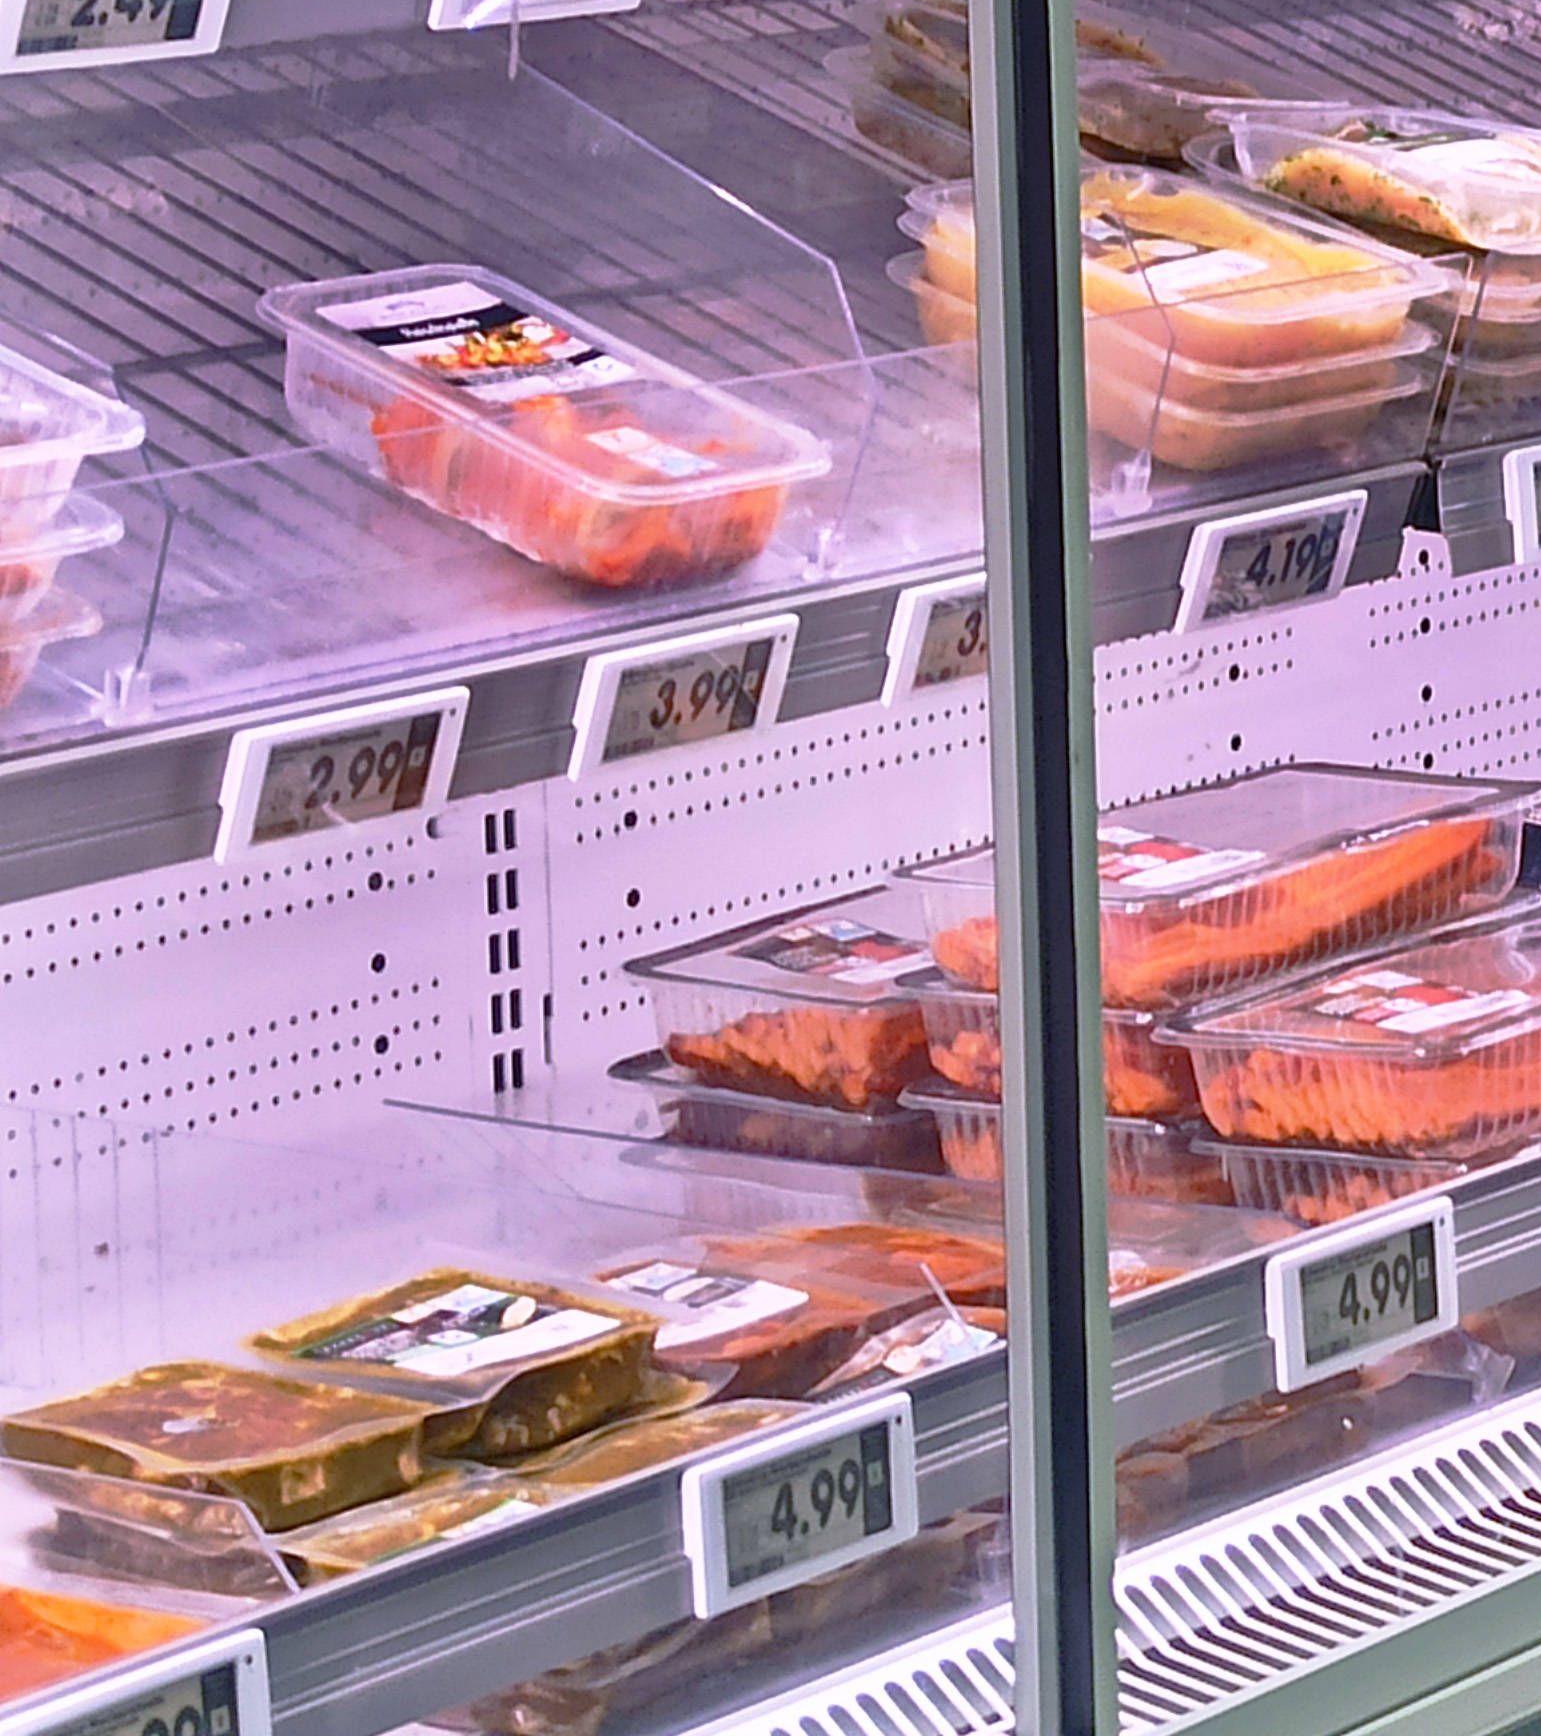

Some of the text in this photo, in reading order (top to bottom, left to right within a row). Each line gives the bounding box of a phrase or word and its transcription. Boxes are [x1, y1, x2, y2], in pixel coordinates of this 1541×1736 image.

[1246, 533, 1317, 587] 4.19
[649, 663, 738, 731] 3.99
[303, 741, 403, 810] 2.99
[1338, 1254, 1412, 1326] 4.99
[771, 1458, 861, 1540] 4.99
